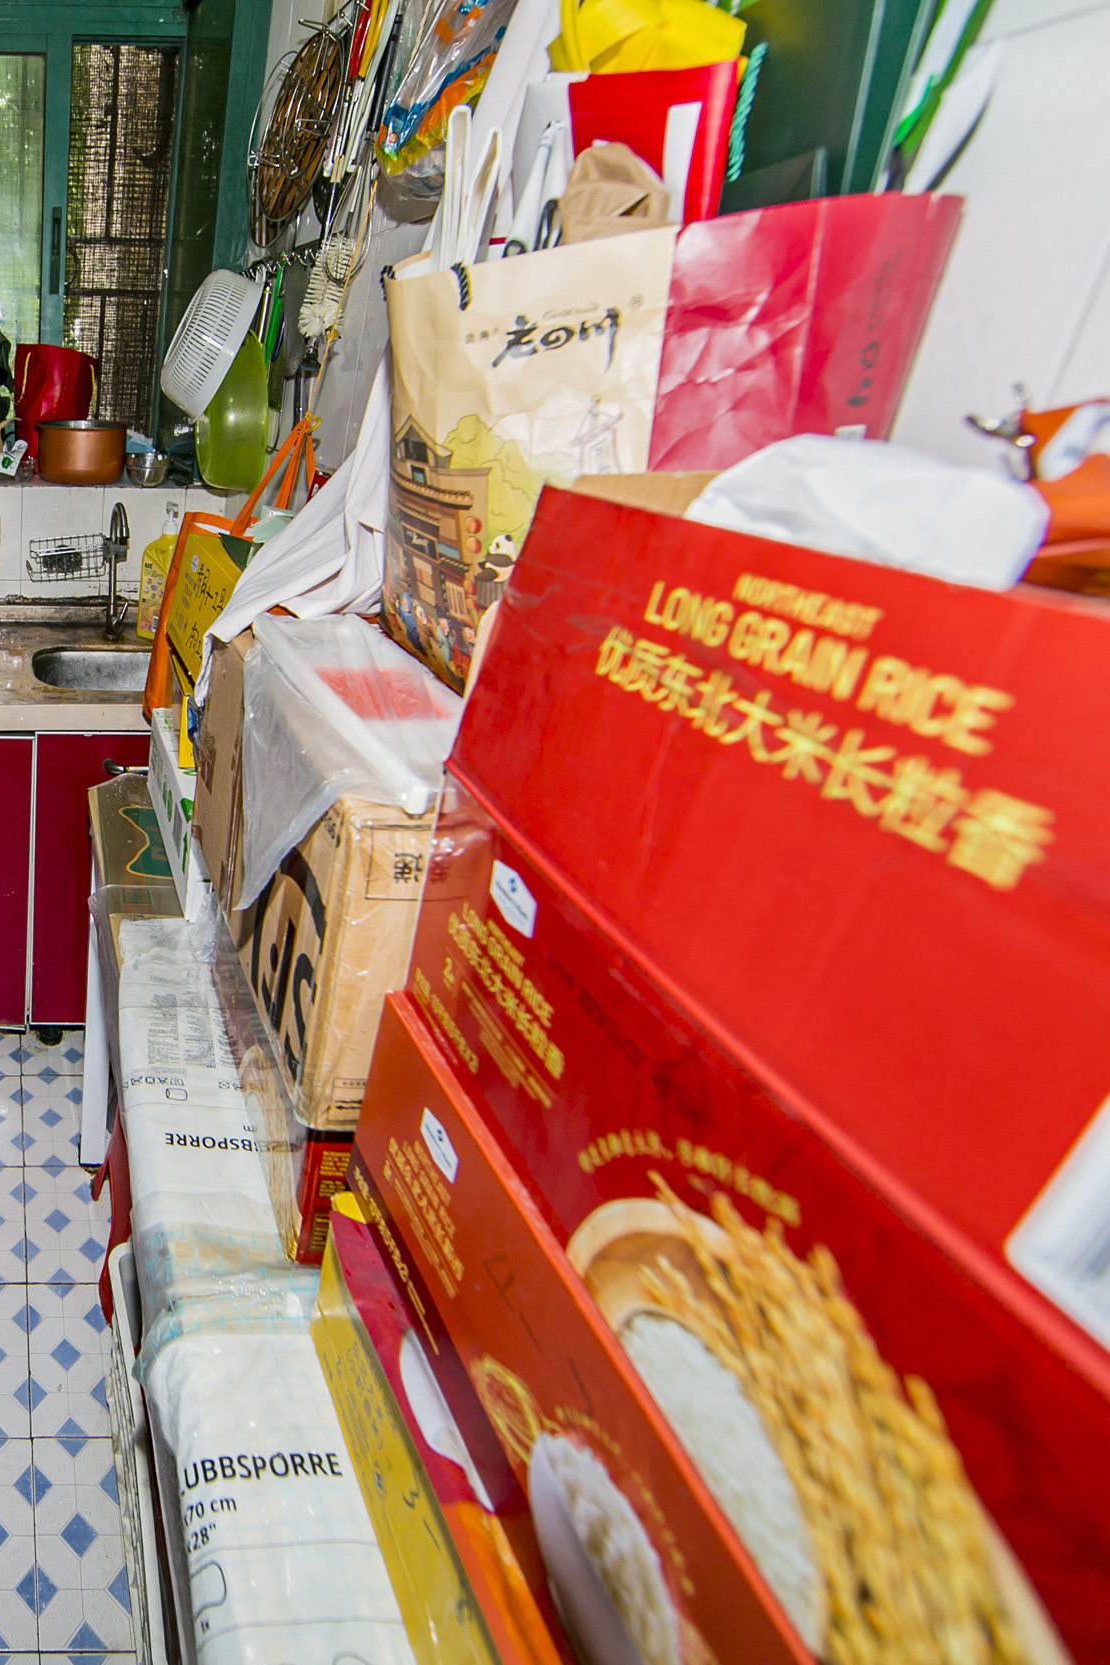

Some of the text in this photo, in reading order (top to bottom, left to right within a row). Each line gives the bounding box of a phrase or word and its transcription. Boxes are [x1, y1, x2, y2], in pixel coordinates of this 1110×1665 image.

[644, 581, 1016, 756] LONG GRAIN RICE
[595, 626, 1057, 891] 优质东北大米长粒香
[181, 1452, 344, 1496] UBBSPORRE
[210, 1497, 238, 1514] cm
